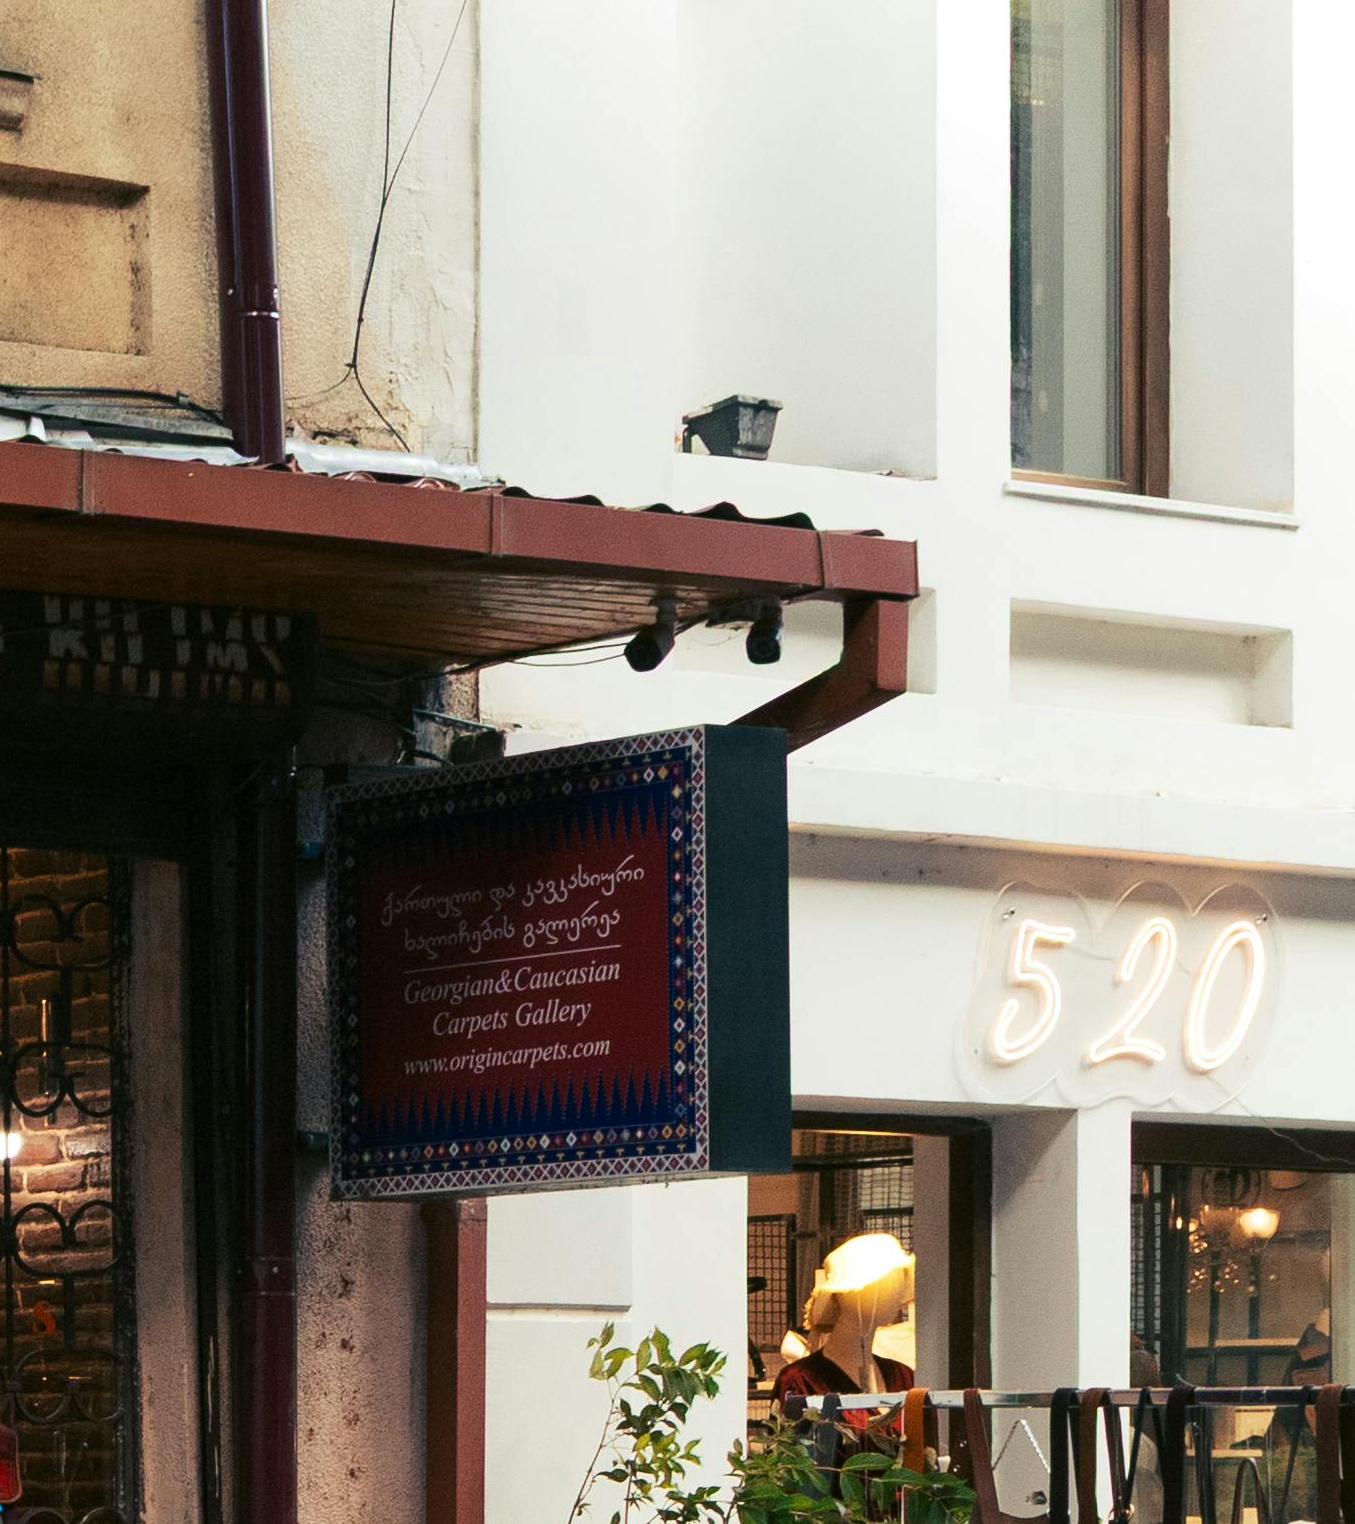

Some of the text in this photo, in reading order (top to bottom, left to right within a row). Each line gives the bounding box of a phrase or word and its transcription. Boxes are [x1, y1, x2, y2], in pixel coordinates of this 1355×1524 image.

[381, 854, 645, 926] ქართული და კავკასიური
[404, 900, 620, 960] ხალიჩების გალერეა
[403, 960, 620, 1005] Georgian&Caucasian
[432, 998, 592, 1039] Carpets Gallery
[404, 1038, 610, 1075] www.origincarpets.com
